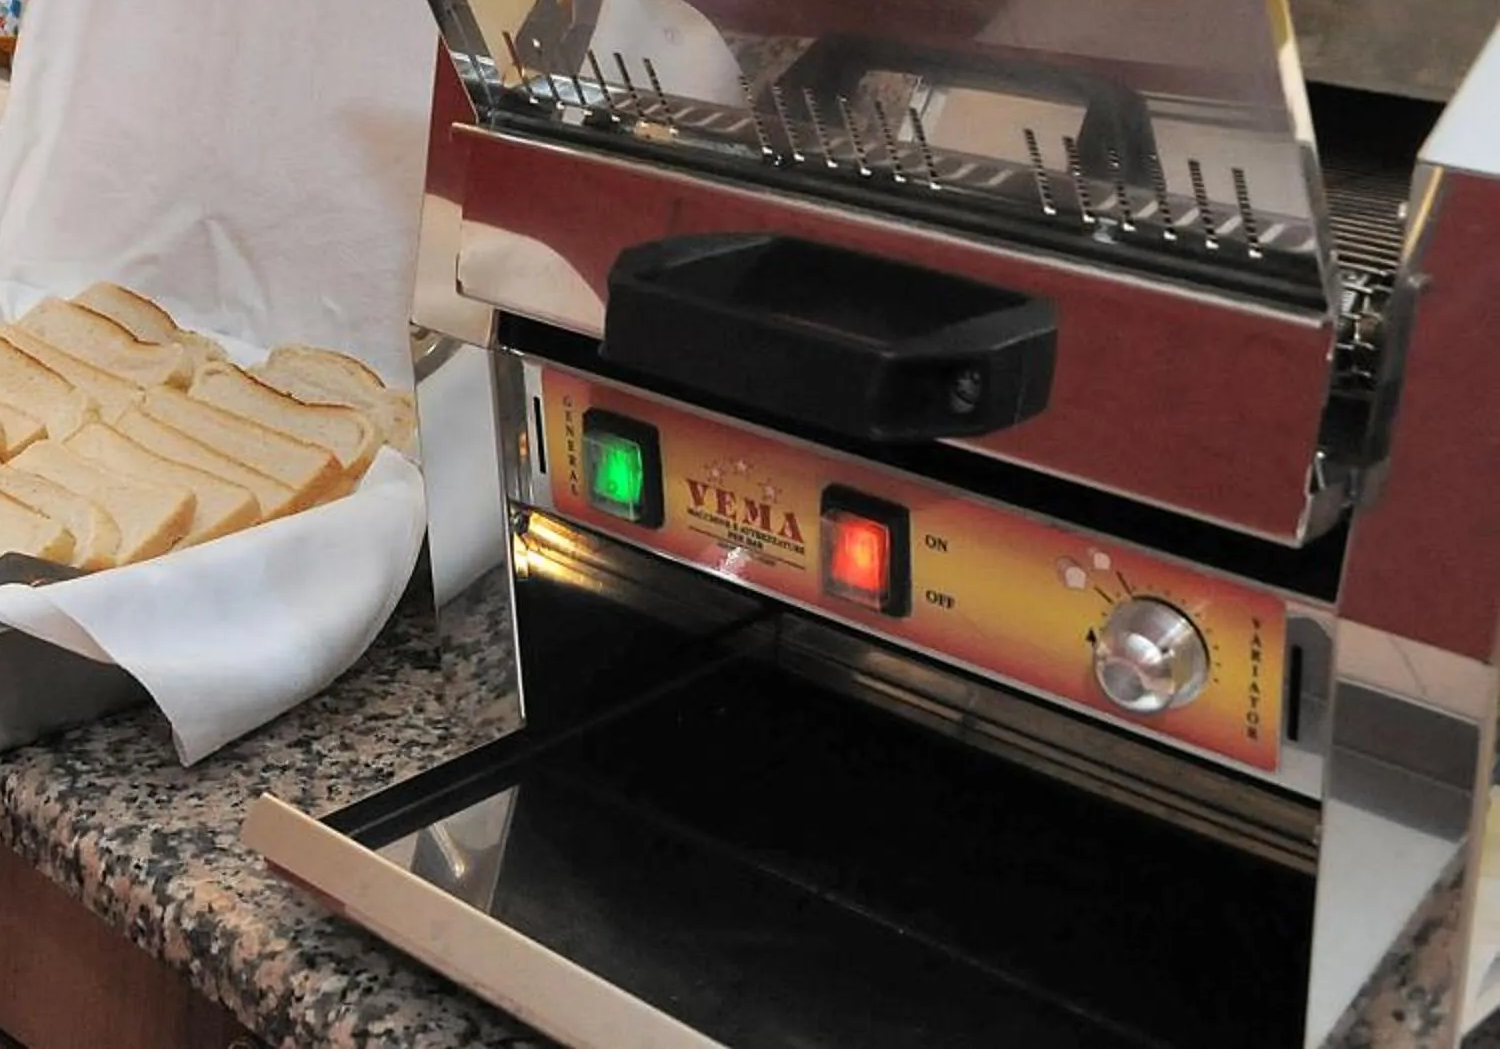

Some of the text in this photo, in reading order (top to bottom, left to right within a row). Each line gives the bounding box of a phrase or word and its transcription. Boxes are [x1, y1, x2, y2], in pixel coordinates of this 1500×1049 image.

[563, 394, 579, 497] GENERAL
[685, 478, 805, 544] VEMA
[924, 534, 948, 552] ON
[924, 590, 955, 610] OFF
[1245, 617, 1261, 740] VARIATOR
